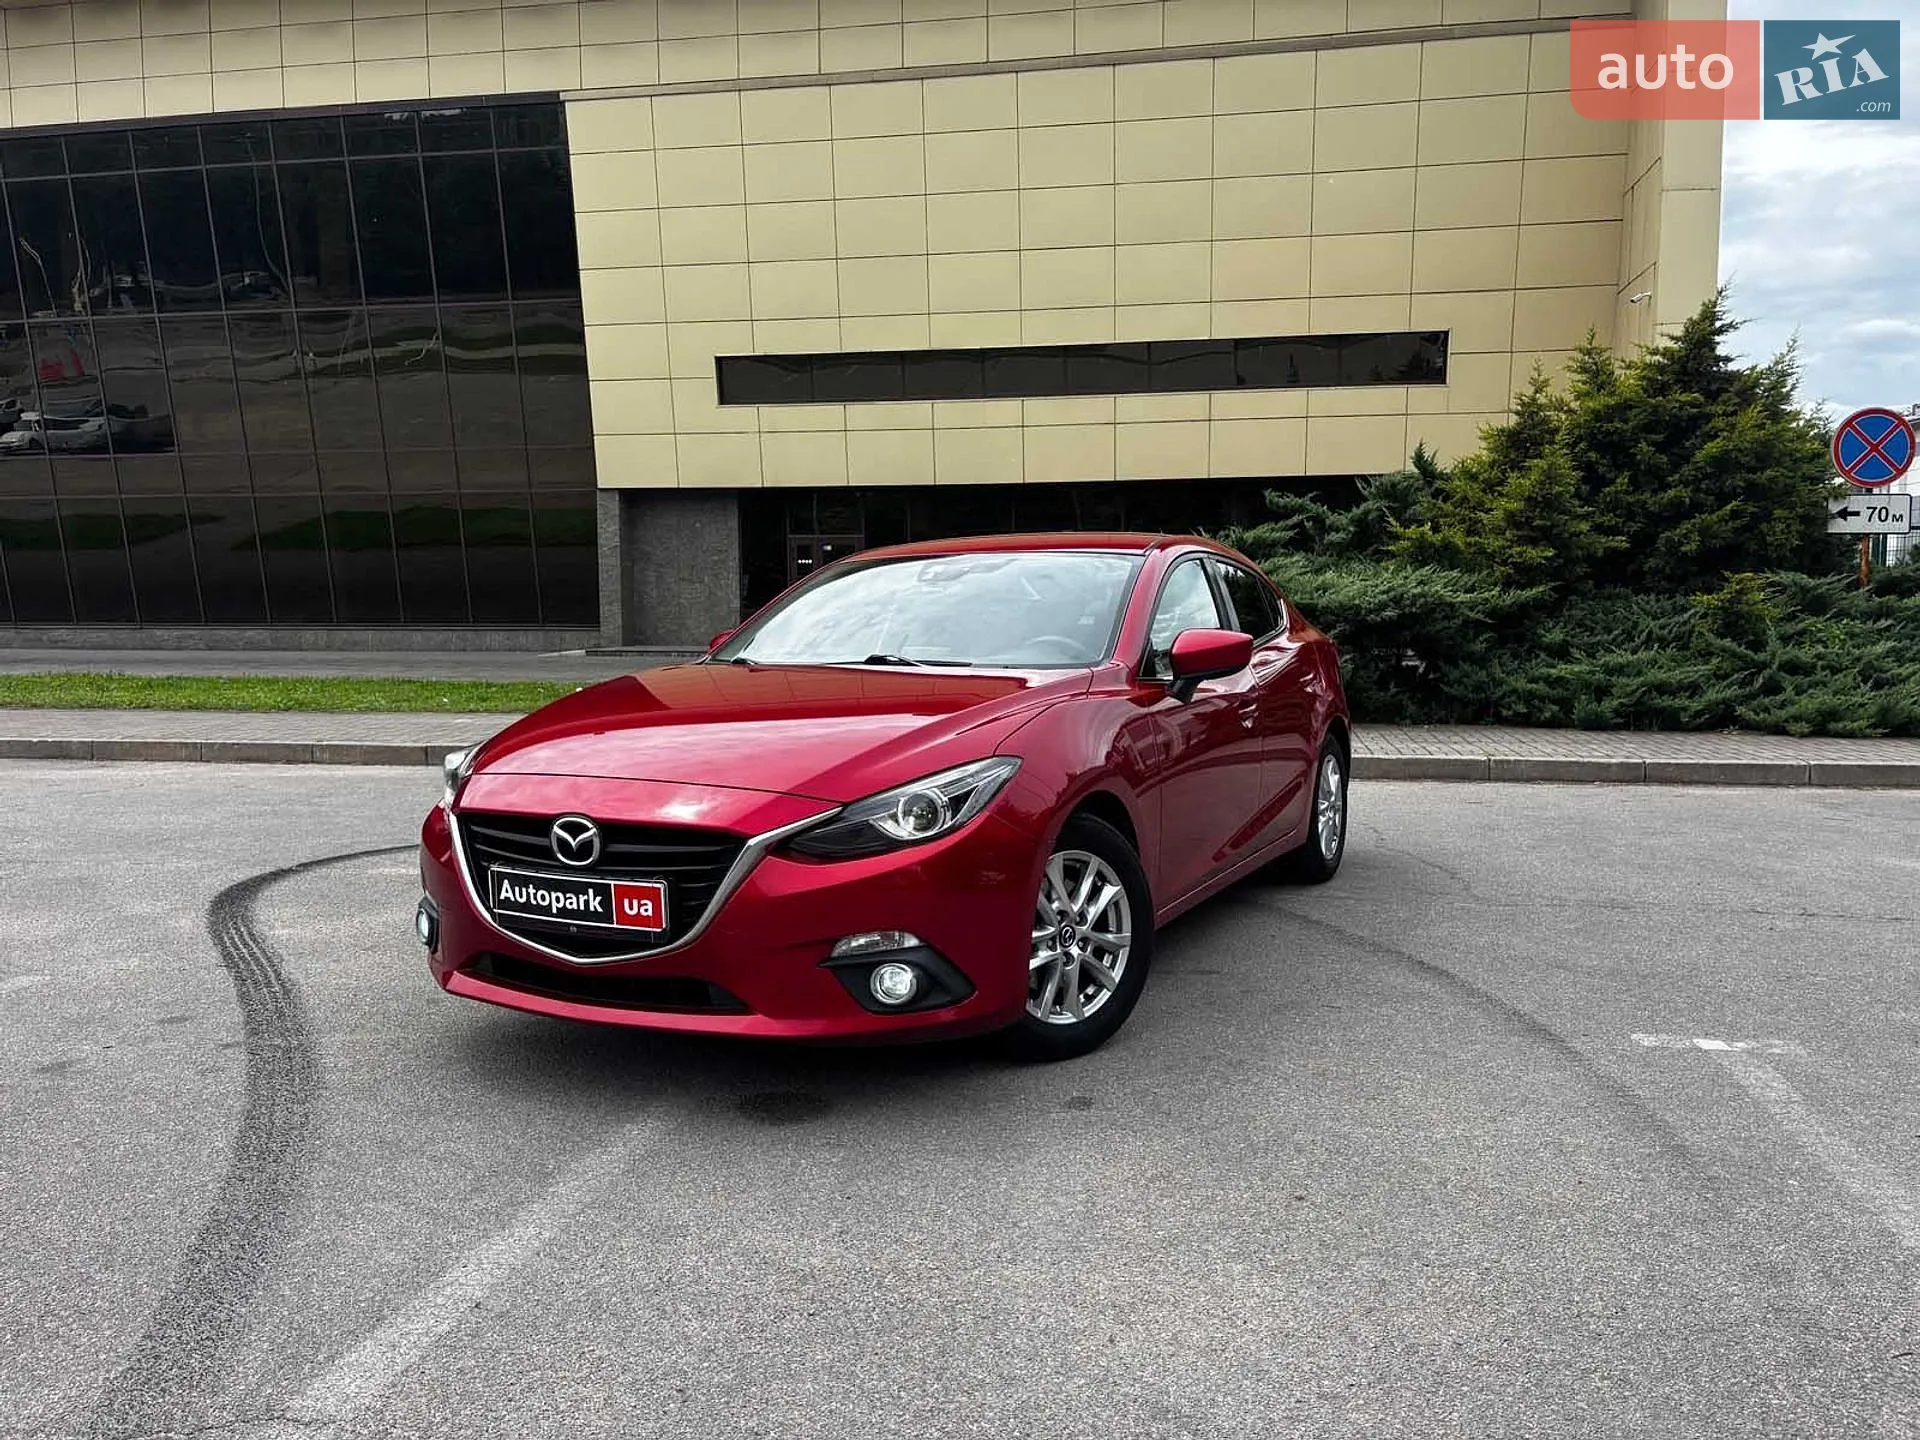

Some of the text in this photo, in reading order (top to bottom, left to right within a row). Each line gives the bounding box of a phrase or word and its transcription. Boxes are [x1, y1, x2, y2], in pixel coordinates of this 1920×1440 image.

[1865, 506, 1890, 523] 70
[499, 879, 653, 917] Autopark ua
